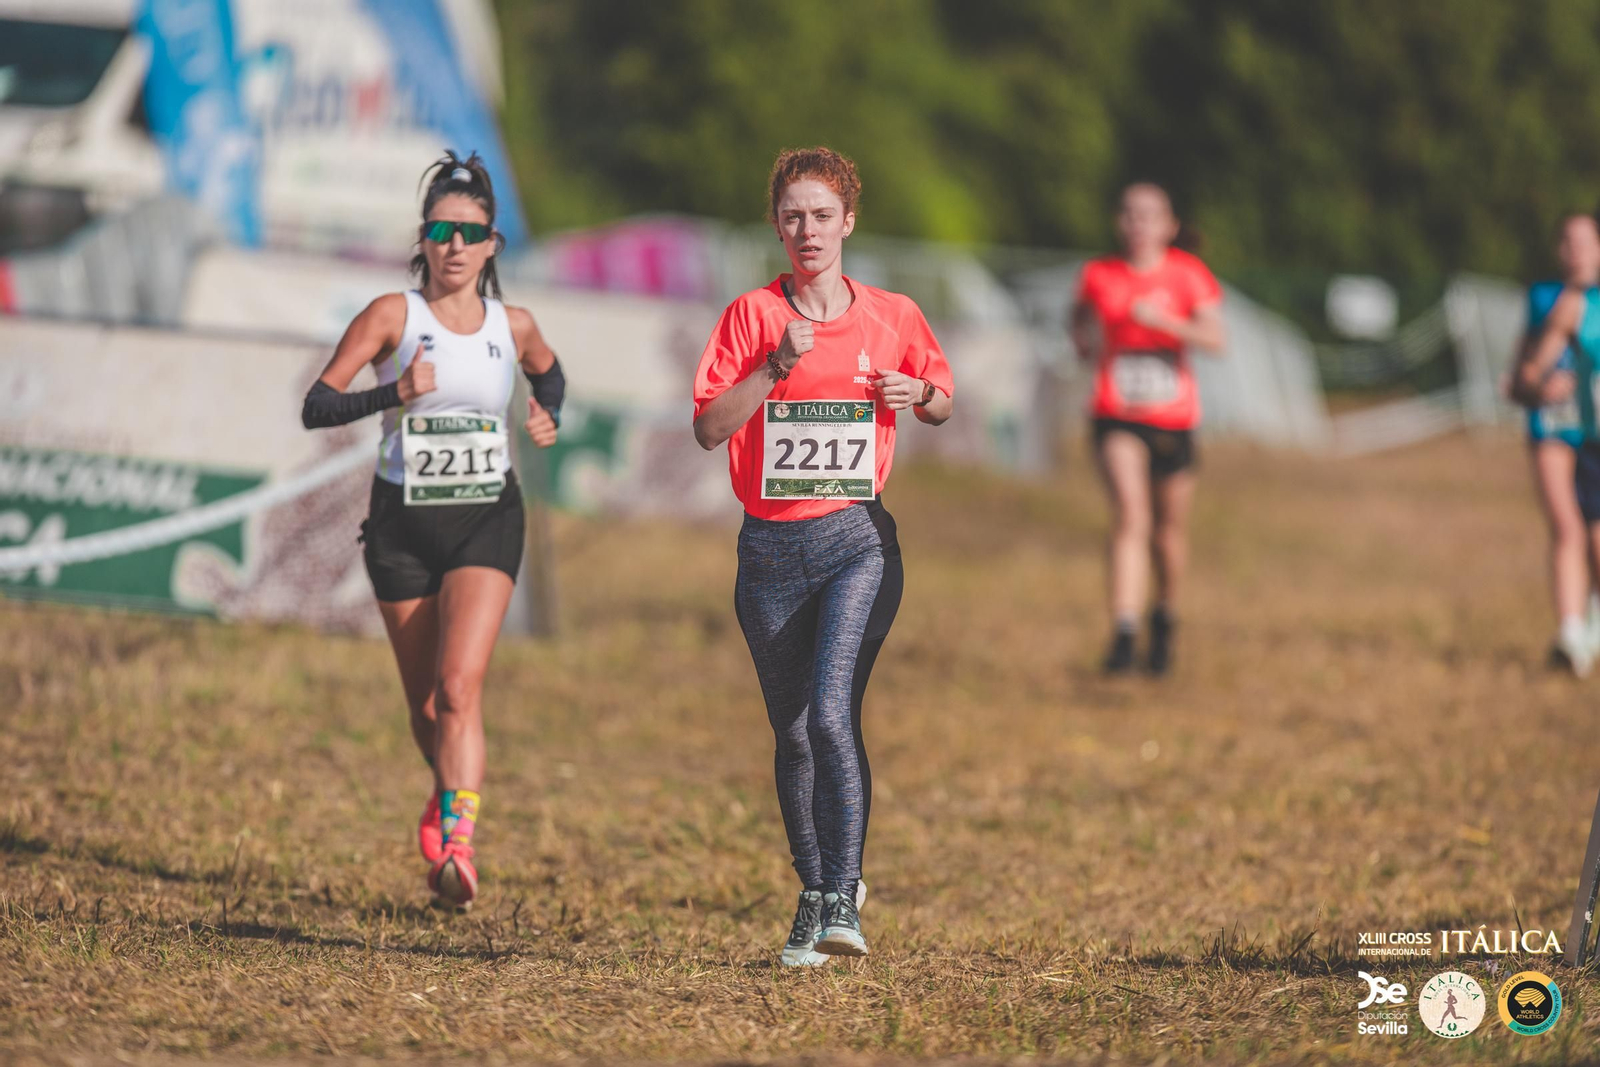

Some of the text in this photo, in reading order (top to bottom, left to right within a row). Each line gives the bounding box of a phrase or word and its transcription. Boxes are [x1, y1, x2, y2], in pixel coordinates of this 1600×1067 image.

[797, 403, 848, 416] ITÁLICA
[416, 448, 496, 476] 2211
[774, 438, 867, 470] 2217
